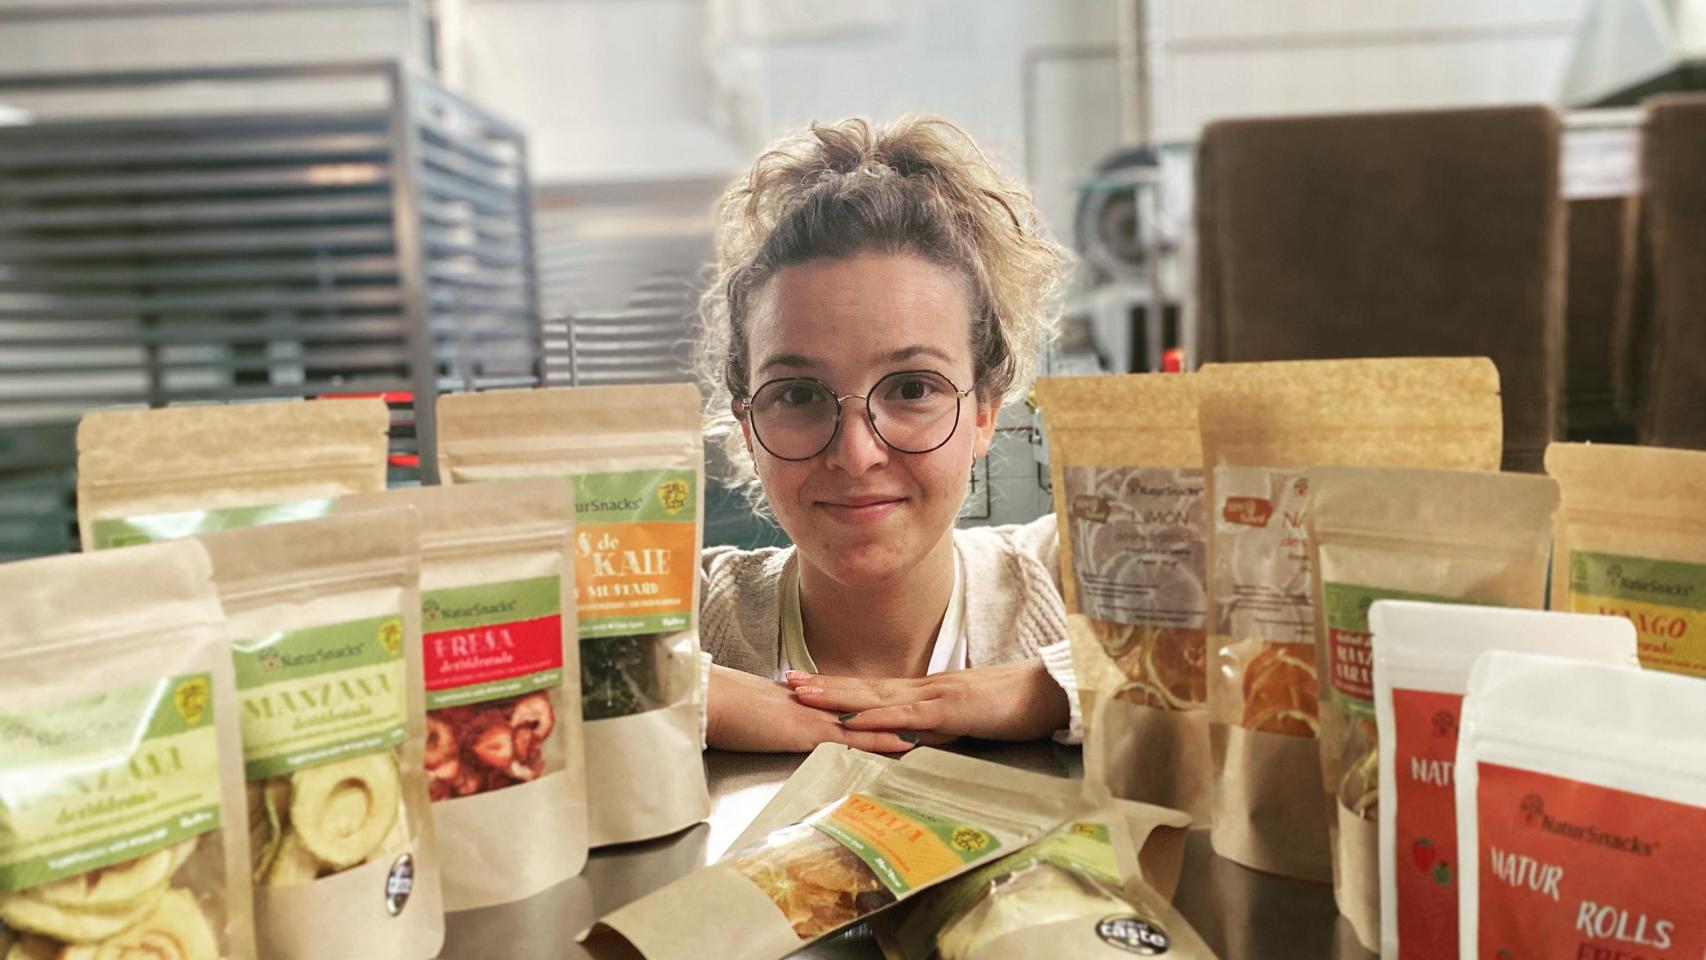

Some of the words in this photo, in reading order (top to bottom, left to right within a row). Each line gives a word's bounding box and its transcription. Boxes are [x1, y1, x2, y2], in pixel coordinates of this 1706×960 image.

[597, 532, 620, 550] de
[591, 548, 672, 578] KALE
[587, 583, 660, 599] MUSTARD
[1490, 847, 1564, 902] NATUR
[1100, 923, 1166, 948] taste
[1576, 899, 1675, 950] ROLLS
